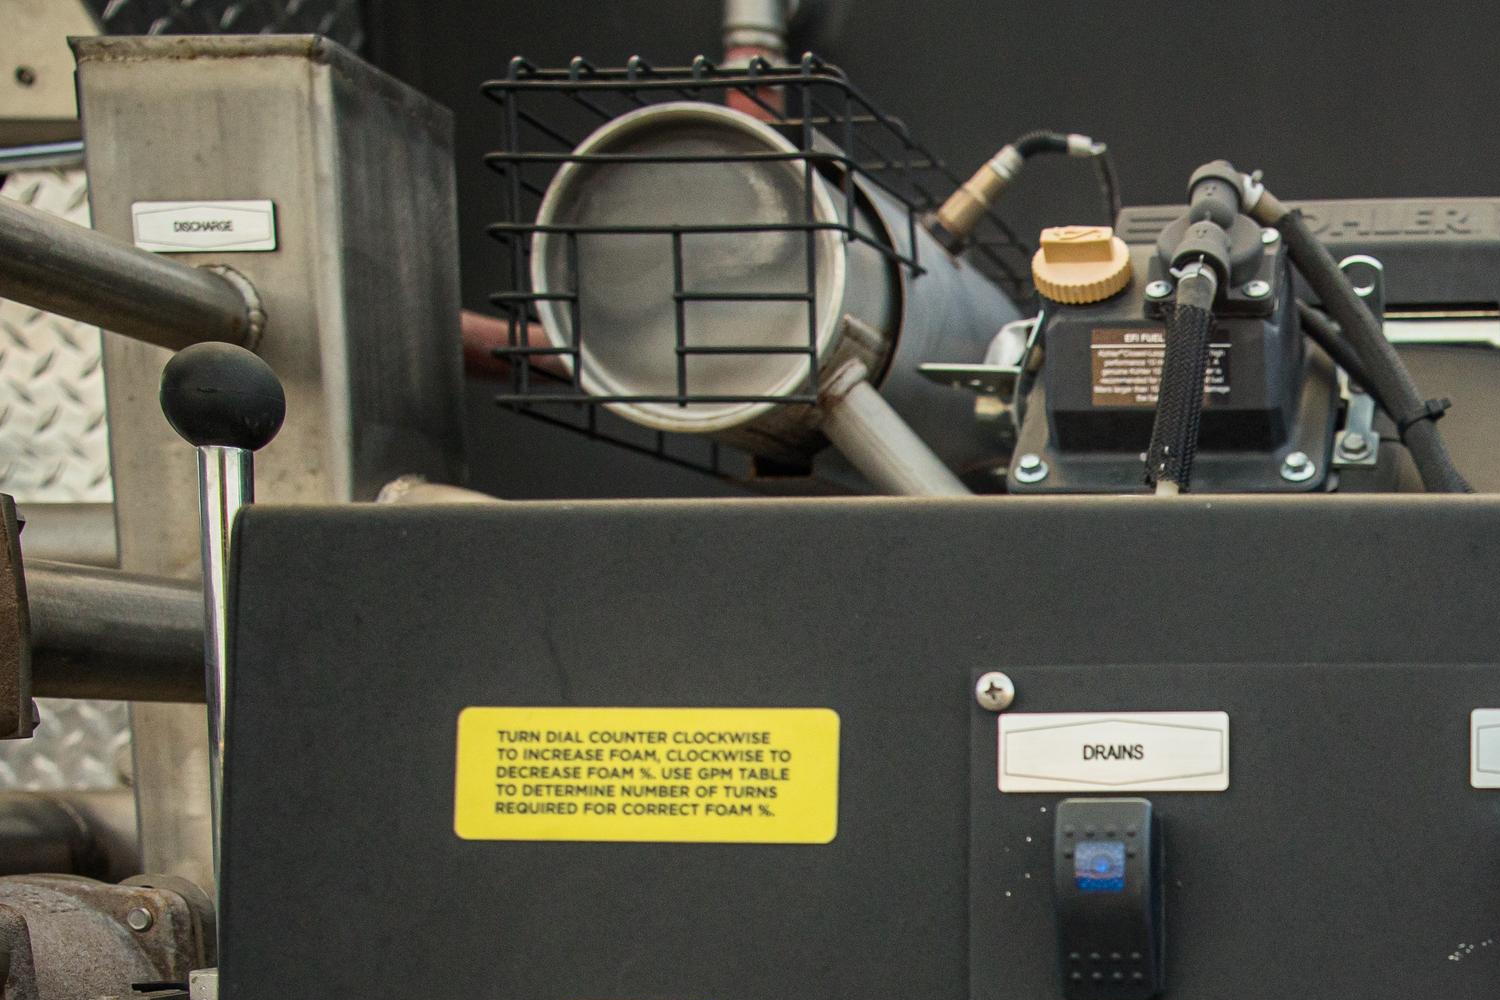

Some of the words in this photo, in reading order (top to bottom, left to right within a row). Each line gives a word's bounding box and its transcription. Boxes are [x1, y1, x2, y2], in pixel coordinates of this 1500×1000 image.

[174, 221, 234, 232] DISCHARGE
[497, 731, 541, 744] TURN
[546, 731, 584, 744] DIAL
[588, 731, 668, 745] COUNTER
[672, 731, 771, 745] CLOCKWISE
[497, 748, 518, 761] TO
[523, 748, 604, 762] INCREASE
[609, 748, 660, 764] FOAM,
[666, 749, 765, 763] CLOCKWISE
[769, 750, 792, 763] TO
[1082, 744, 1145, 761] DRAINS
[496, 766, 582, 779] DECREASE
[586, 766, 635, 779] FOAM
[661, 767, 693, 780] USE
[698, 767, 733, 781] GPM
[738, 768, 790, 781] TABLE
[496, 784, 517, 797] TO
[522, 784, 616, 798] DETERMINE
[620, 784, 690, 798] NUMBER
[694, 785, 719, 798] OF
[723, 785, 778, 799] TURNS
[494, 801, 578, 816] REQUIRED
[583, 802, 618, 815] FOR
[622, 802, 700, 816] CORRECT
[704, 803, 753, 816] FOAM
